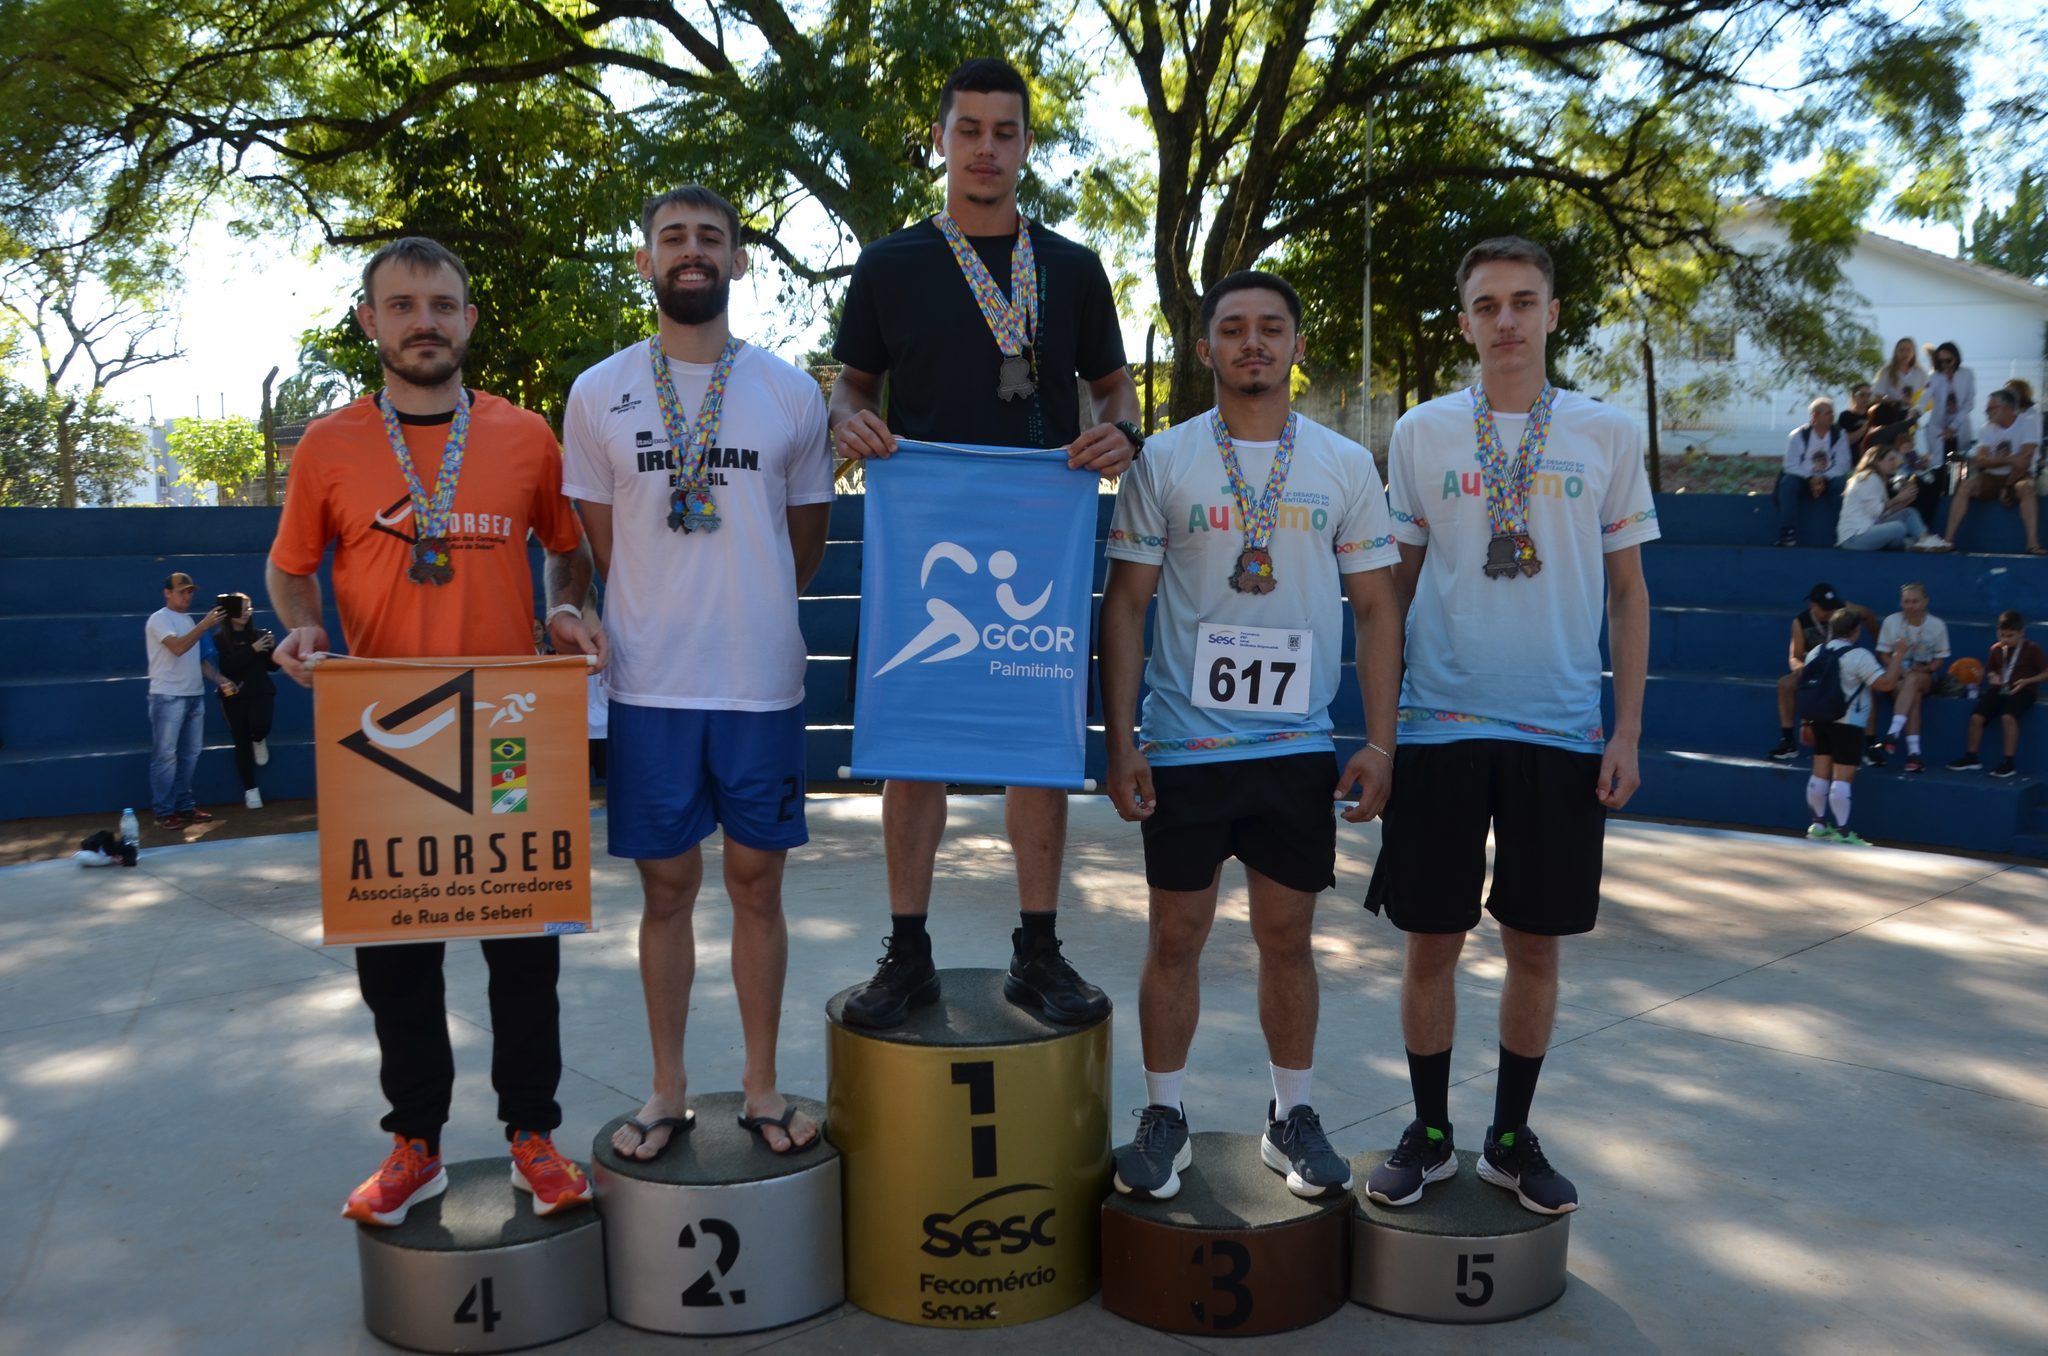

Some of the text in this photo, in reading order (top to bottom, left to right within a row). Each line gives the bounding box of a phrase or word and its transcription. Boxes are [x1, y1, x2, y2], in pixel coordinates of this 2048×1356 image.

[637, 448, 759, 473] IROMAN
[669, 473, 728, 487] BSIL
[1442, 470, 1583, 500] Aumo
[449, 512, 513, 537] ORSEB
[982, 623, 1075, 653] GCOR
[990, 661, 1074, 680] Palmitinho
[1209, 656, 1297, 706] 617
[351, 830, 572, 880] ACORSEB
[348, 877, 573, 903] Associação dos Corredores
[391, 909, 413, 926] de
[418, 908, 449, 924] Rua
[454, 907, 475, 922] de
[951, 1060, 998, 1179] 1
[678, 1217, 747, 1307] 2
[919, 1266, 1057, 1295] Fecomércio
[1190, 1239, 1253, 1330] 3
[1455, 1253, 1495, 1307] 5
[453, 1277, 502, 1334] 4
[920, 1301, 999, 1321] Senac
